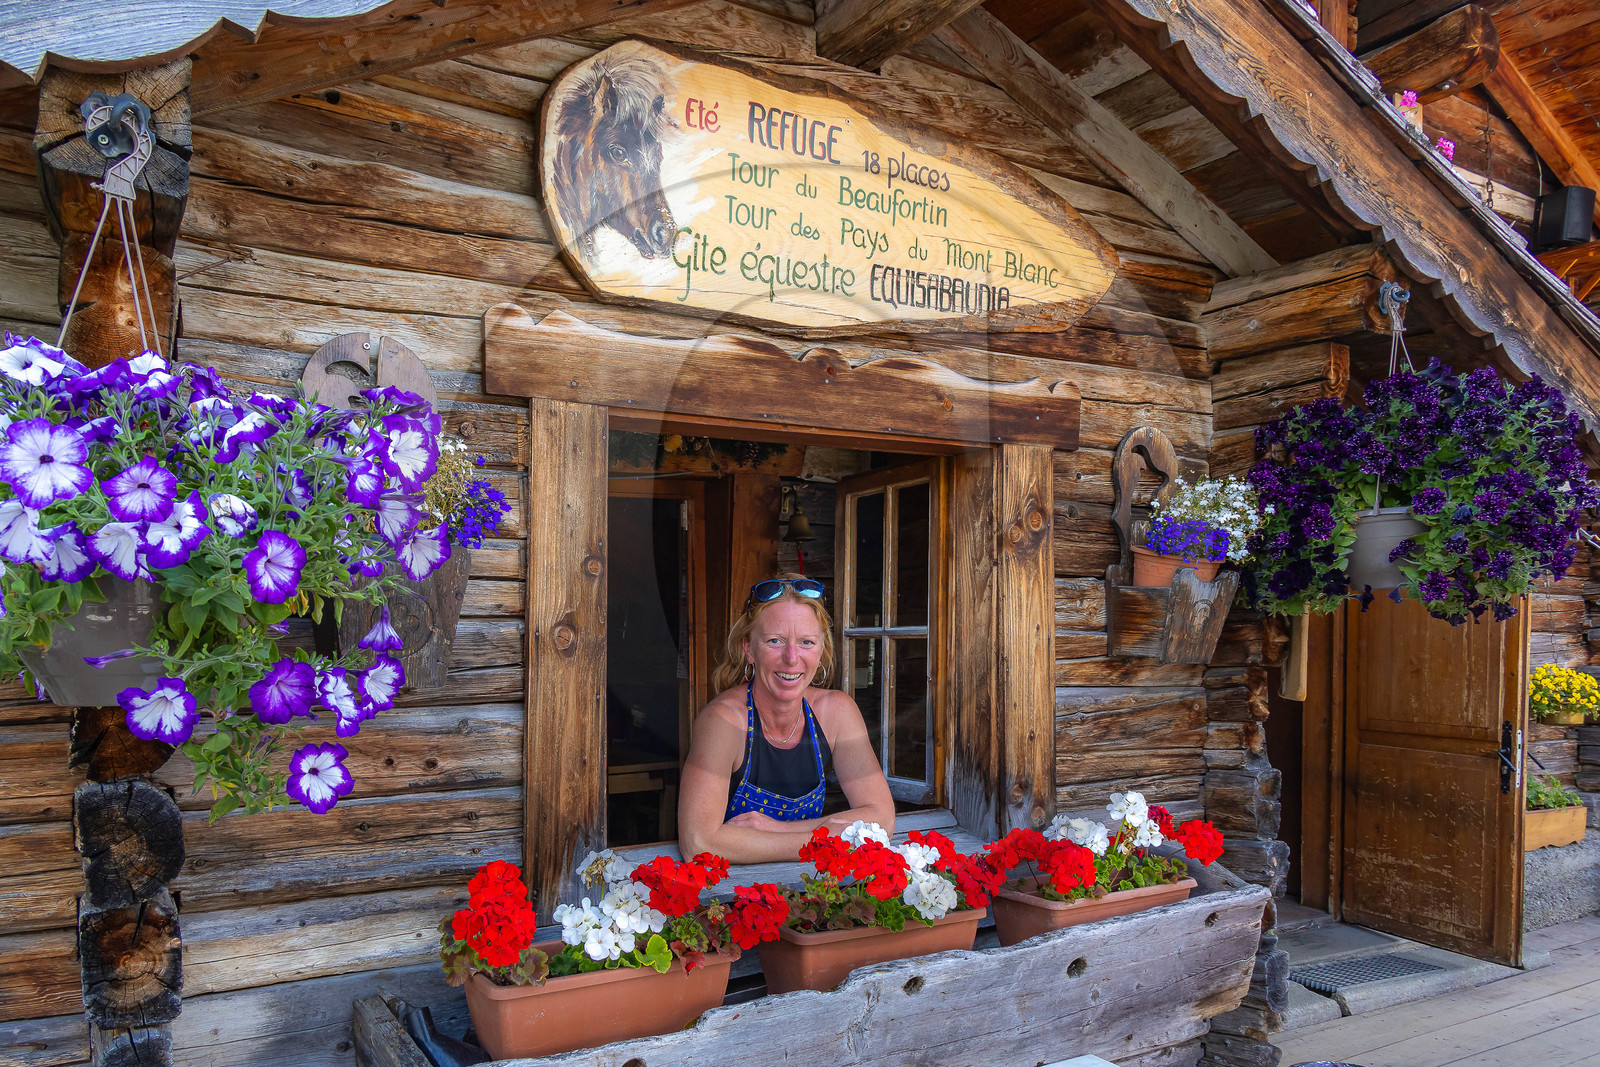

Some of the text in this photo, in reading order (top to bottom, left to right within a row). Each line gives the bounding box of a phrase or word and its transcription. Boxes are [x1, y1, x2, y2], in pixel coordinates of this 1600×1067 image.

[685, 97, 951, 192] Eté REFUGE 18 places
[728, 153, 947, 227] Tour du Beaufortin
[724, 194, 1059, 288] Tour des Pays du Mont Blanc
[740, 242, 856, 303] équestre
[870, 263, 1010, 316] EQUISABAUDIA
